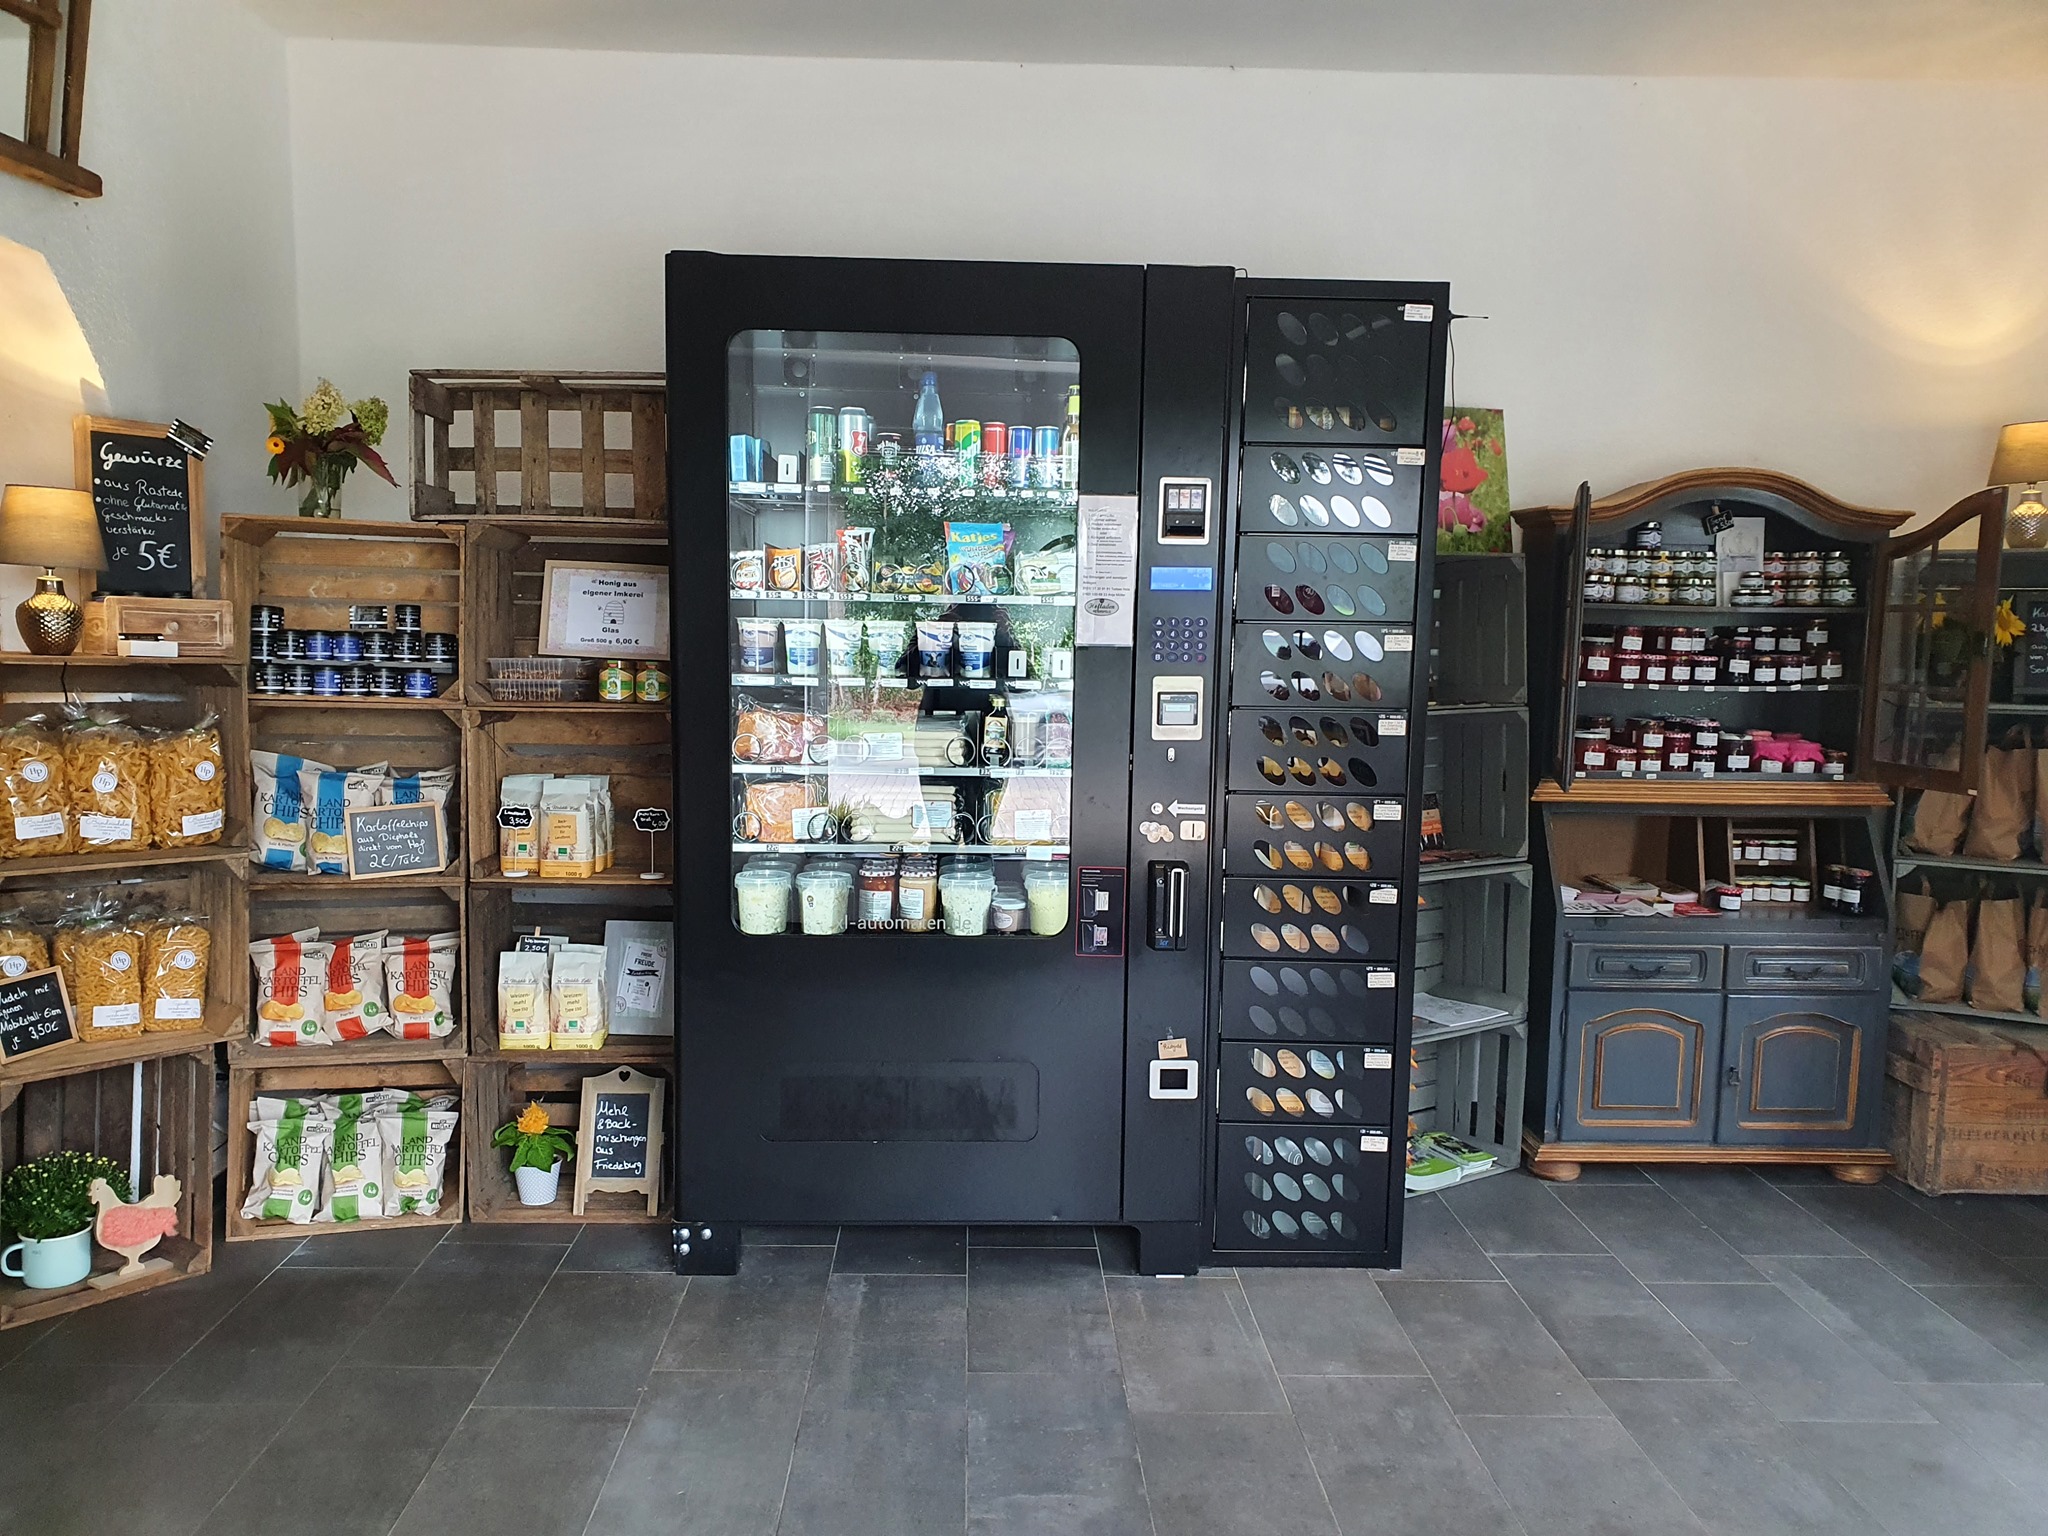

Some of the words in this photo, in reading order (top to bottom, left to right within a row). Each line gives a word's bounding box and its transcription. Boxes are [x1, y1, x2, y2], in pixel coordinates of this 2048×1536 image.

[100, 441, 184, 471] Gewürze
[104, 480, 130, 491] aus
[135, 479, 183, 498] Rastede
[103, 495, 130, 507] ohne
[134, 496, 179, 512] Glutamat
[101, 507, 173, 523] Geschmacks-
[951, 532, 998, 544] Katjes
[112, 546, 129, 561] je
[137, 541, 178, 571] 5€
[598, 579, 621, 588] Honig
[582, 589, 612, 597] eigener
[614, 590, 644, 598] Imkerei
[318, 797, 350, 808] LAND
[263, 802, 309, 820] CHIPS
[311, 816, 345, 830] CHIP
[356, 817, 429, 833] Kartoffelchips
[357, 836, 374, 844] aus
[358, 843, 381, 852] direkt
[407, 840, 426, 854] Hof
[369, 853, 422, 869] 2€/Tüte
[275, 966, 307, 976] LAND
[404, 961, 435, 970] LAND
[259, 976, 321, 986] KARTOFFEL
[395, 978, 438, 993] CHIPS
[0, 987, 28, 1004] udeln
[35, 983, 50, 995] mit
[263, 985, 308, 998] CHIPS
[597, 1101, 629, 1116] Mehl
[276, 1136, 307, 1147] LAND
[402, 1135, 433, 1145] LAND
[596, 1133, 647, 1147] mischungen
[595, 1147, 614, 1155] aus
[268, 1151, 309, 1167] CHIPS
[394, 1153, 434, 1167] CHIPS
[594, 1158, 642, 1174] Friedeburg
